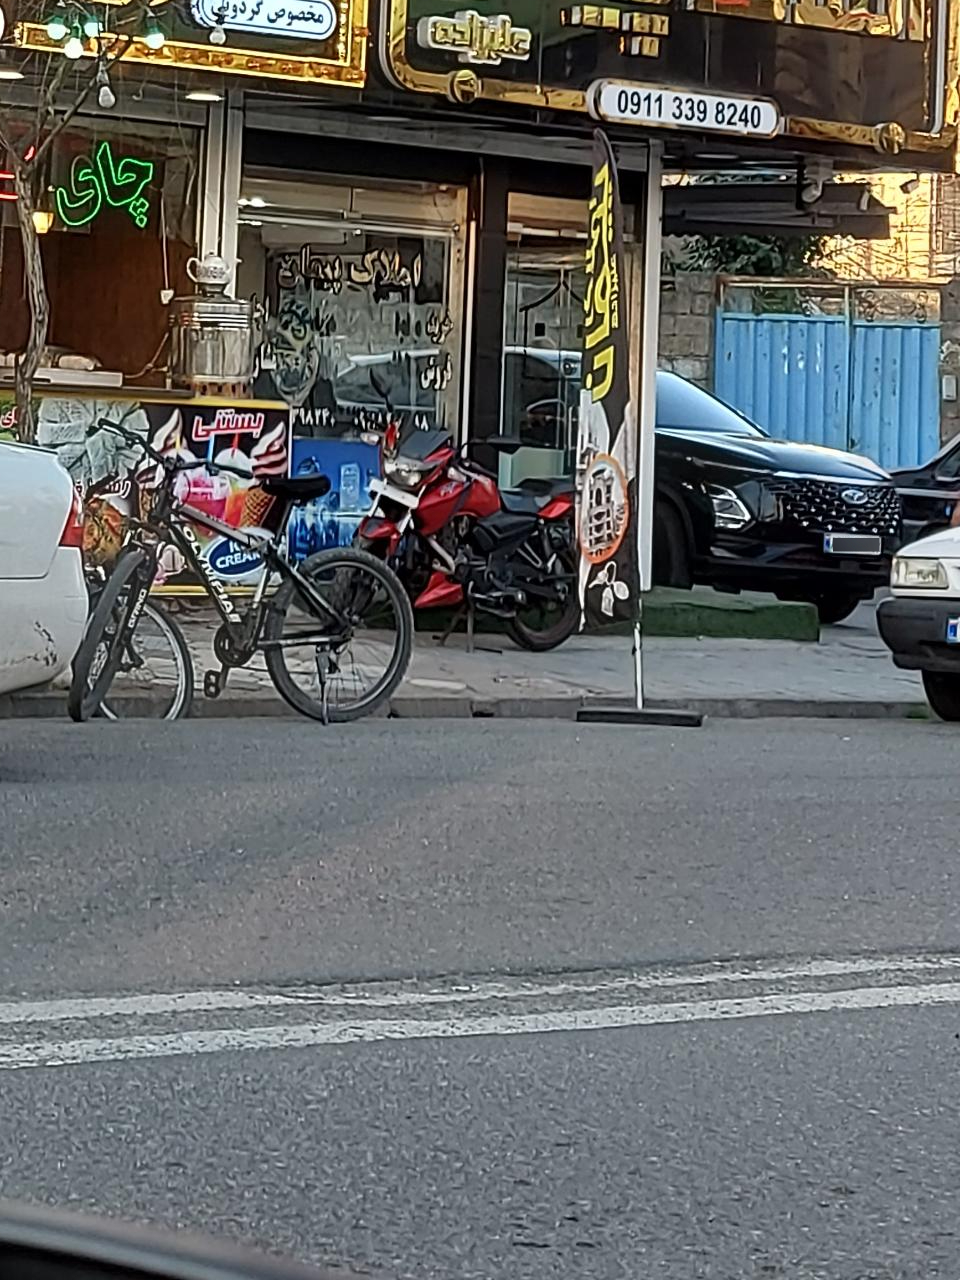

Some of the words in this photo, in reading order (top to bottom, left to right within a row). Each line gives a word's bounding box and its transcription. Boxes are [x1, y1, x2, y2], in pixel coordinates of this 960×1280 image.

[267, 5, 324, 26] مخصوص
[617, 90, 664, 118] 0911
[672, 96, 707, 123] 339
[715, 101, 761, 128] 8240
[55, 141, 154, 227] چای
[192, 408, 265, 442] بستنی
